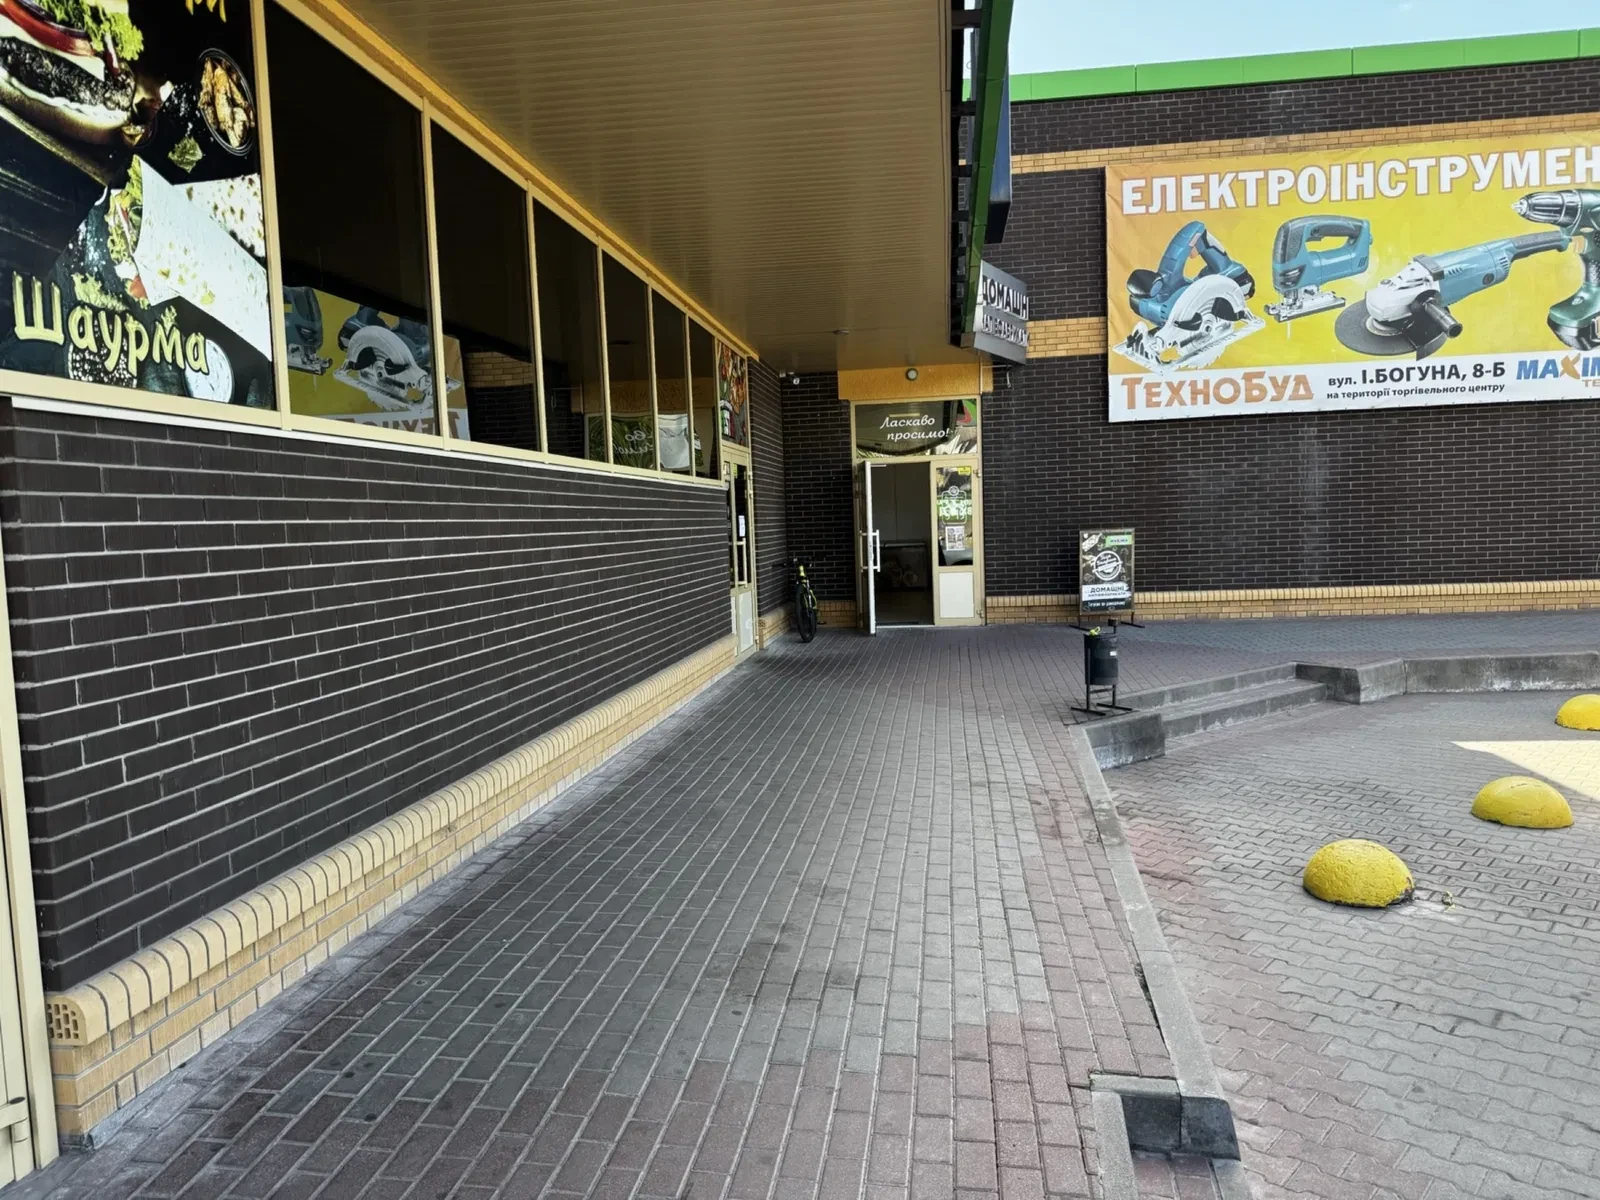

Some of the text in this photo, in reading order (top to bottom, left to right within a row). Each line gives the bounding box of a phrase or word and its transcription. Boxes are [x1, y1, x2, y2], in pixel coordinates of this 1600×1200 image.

[12, 270, 209, 377] Шаурма
[1328, 377, 1357, 388] вул.
[1472, 362, 1506, 378] 8-Б
[1327, 383, 1506, 400] на території торгівельного центру
[880, 414, 936, 430] Ласкаво
[887, 427, 950, 442] просимо!
